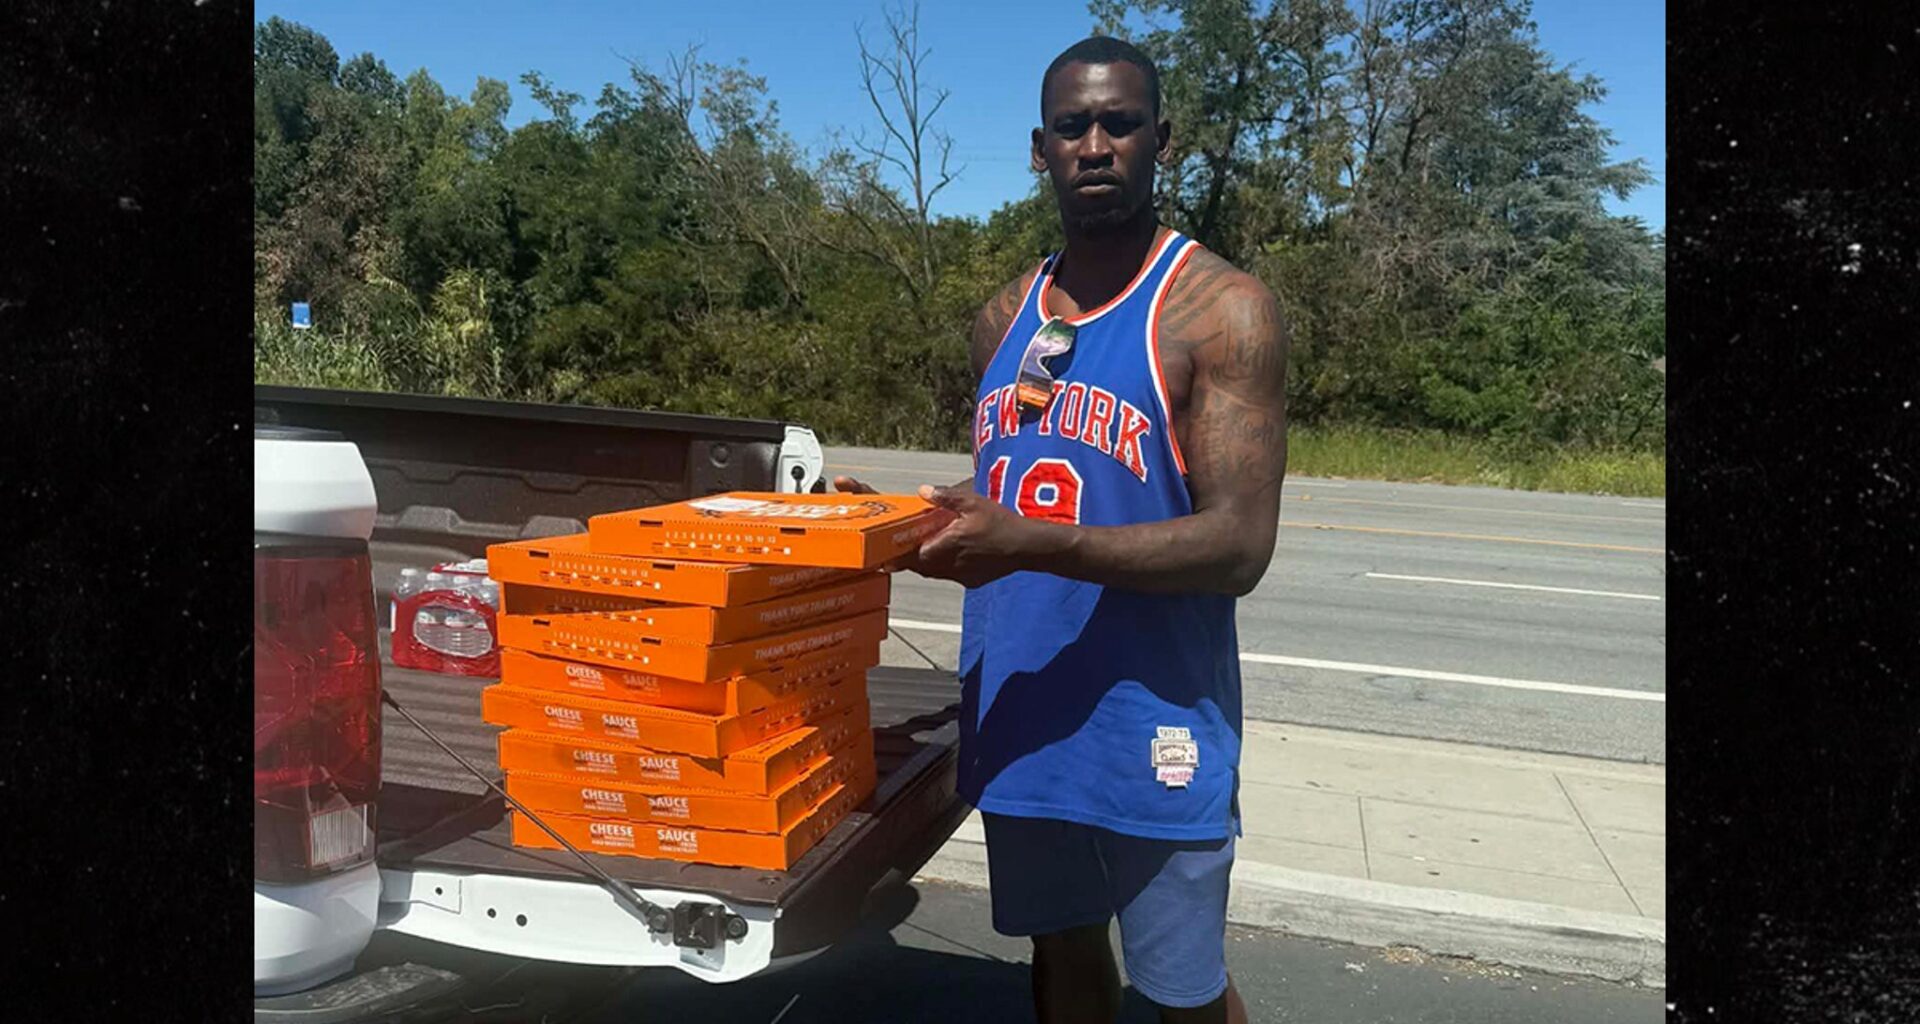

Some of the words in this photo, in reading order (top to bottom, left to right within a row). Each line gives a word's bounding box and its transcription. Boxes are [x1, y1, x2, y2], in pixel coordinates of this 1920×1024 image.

[1038, 380, 1151, 483] YORK
[565, 663, 602, 680] CHEESE
[623, 674, 659, 687] SAUCE
[544, 705, 582, 721] CHEESE
[602, 713, 638, 728] SAUCE
[573, 749, 615, 764] CHEESE
[639, 756, 679, 770] SAUCE
[581, 788, 624, 803] CHEESE
[648, 797, 689, 808] SAUCE
[590, 823, 634, 837] CHEESE
[657, 829, 697, 842] SAUCE
